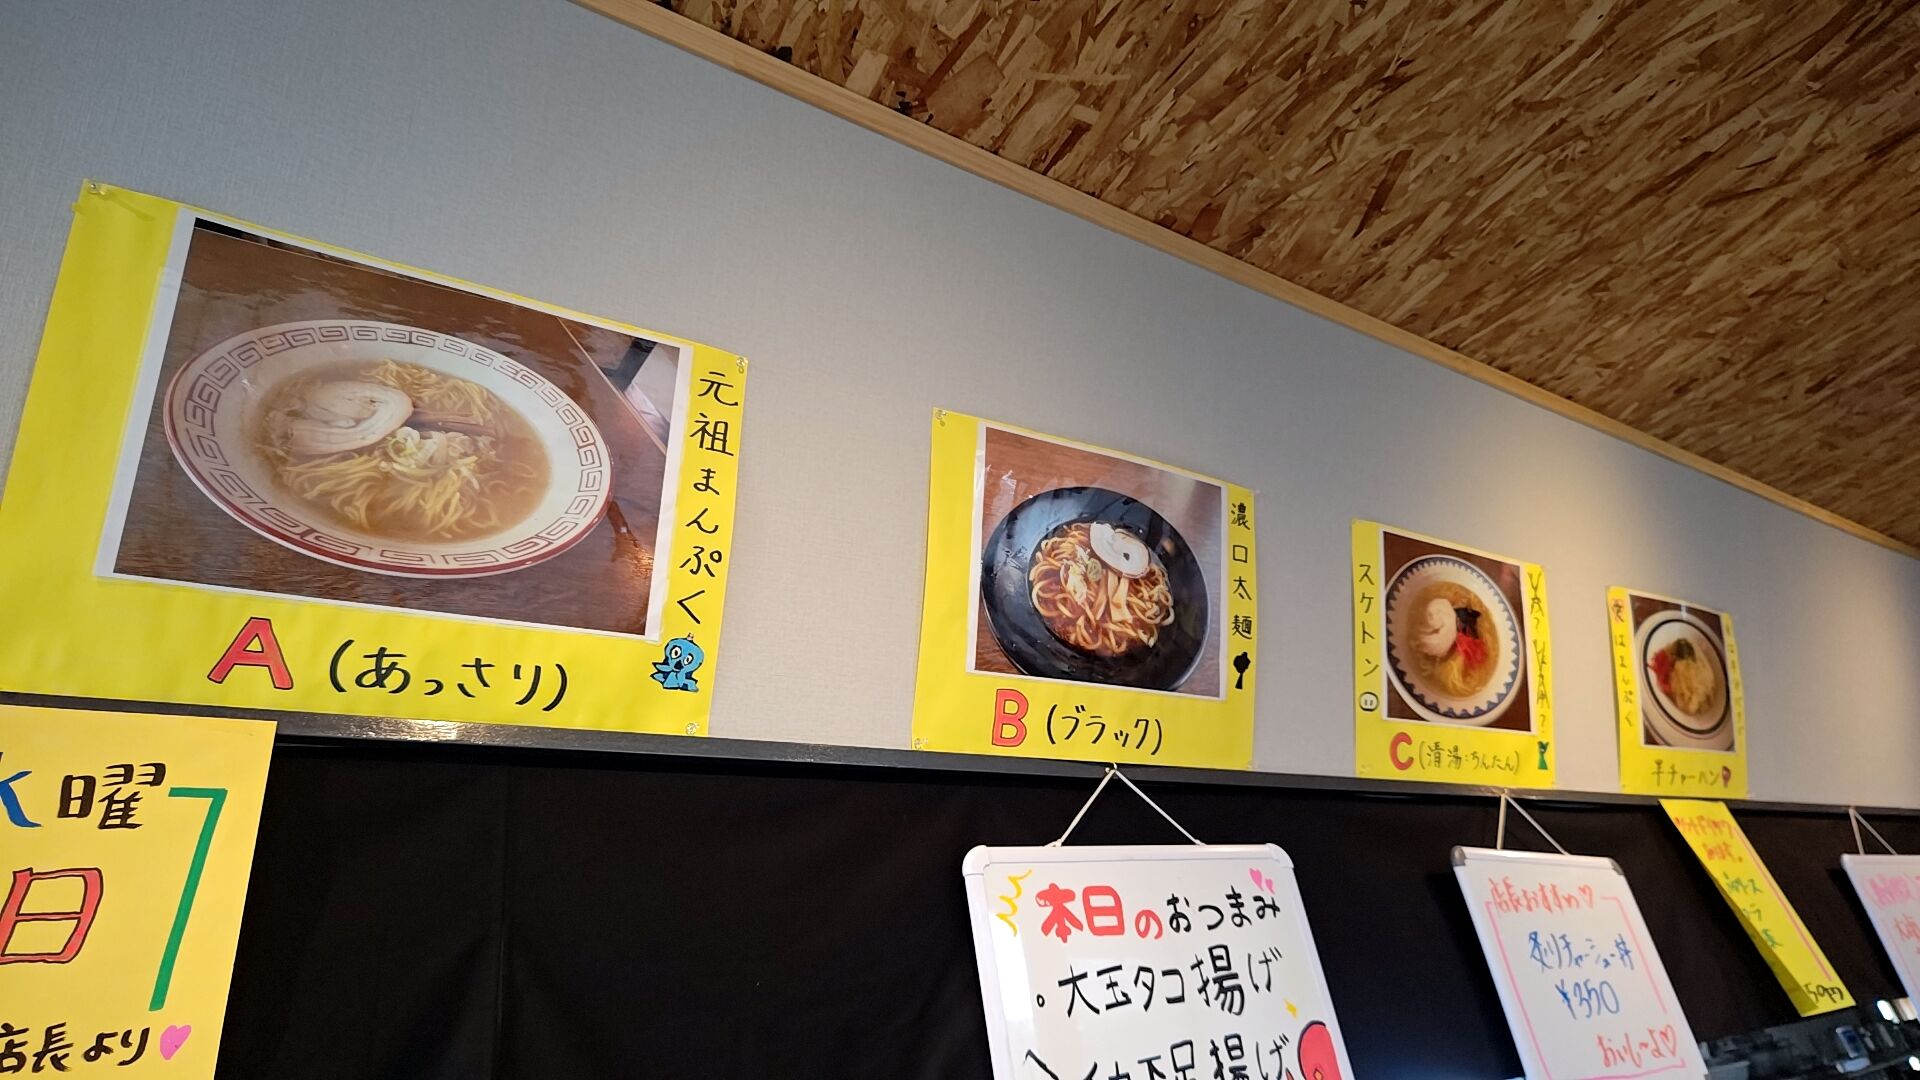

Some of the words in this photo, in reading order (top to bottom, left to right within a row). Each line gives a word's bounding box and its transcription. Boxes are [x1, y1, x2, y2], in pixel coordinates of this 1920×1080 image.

[677, 371, 738, 624] 元祖まんぷく
[1230, 501, 1253, 641] 濃口太麺
[206, 616, 294, 691] A
[328, 638, 569, 712] (あっさり)
[1359, 563, 1379, 678] スケトン
[991, 688, 1029, 748] B
[1046, 703, 1163, 756] (ブラック)
[1389, 731, 1415, 771] C
[1034, 882, 1281, 943] 本日のおつまみ
